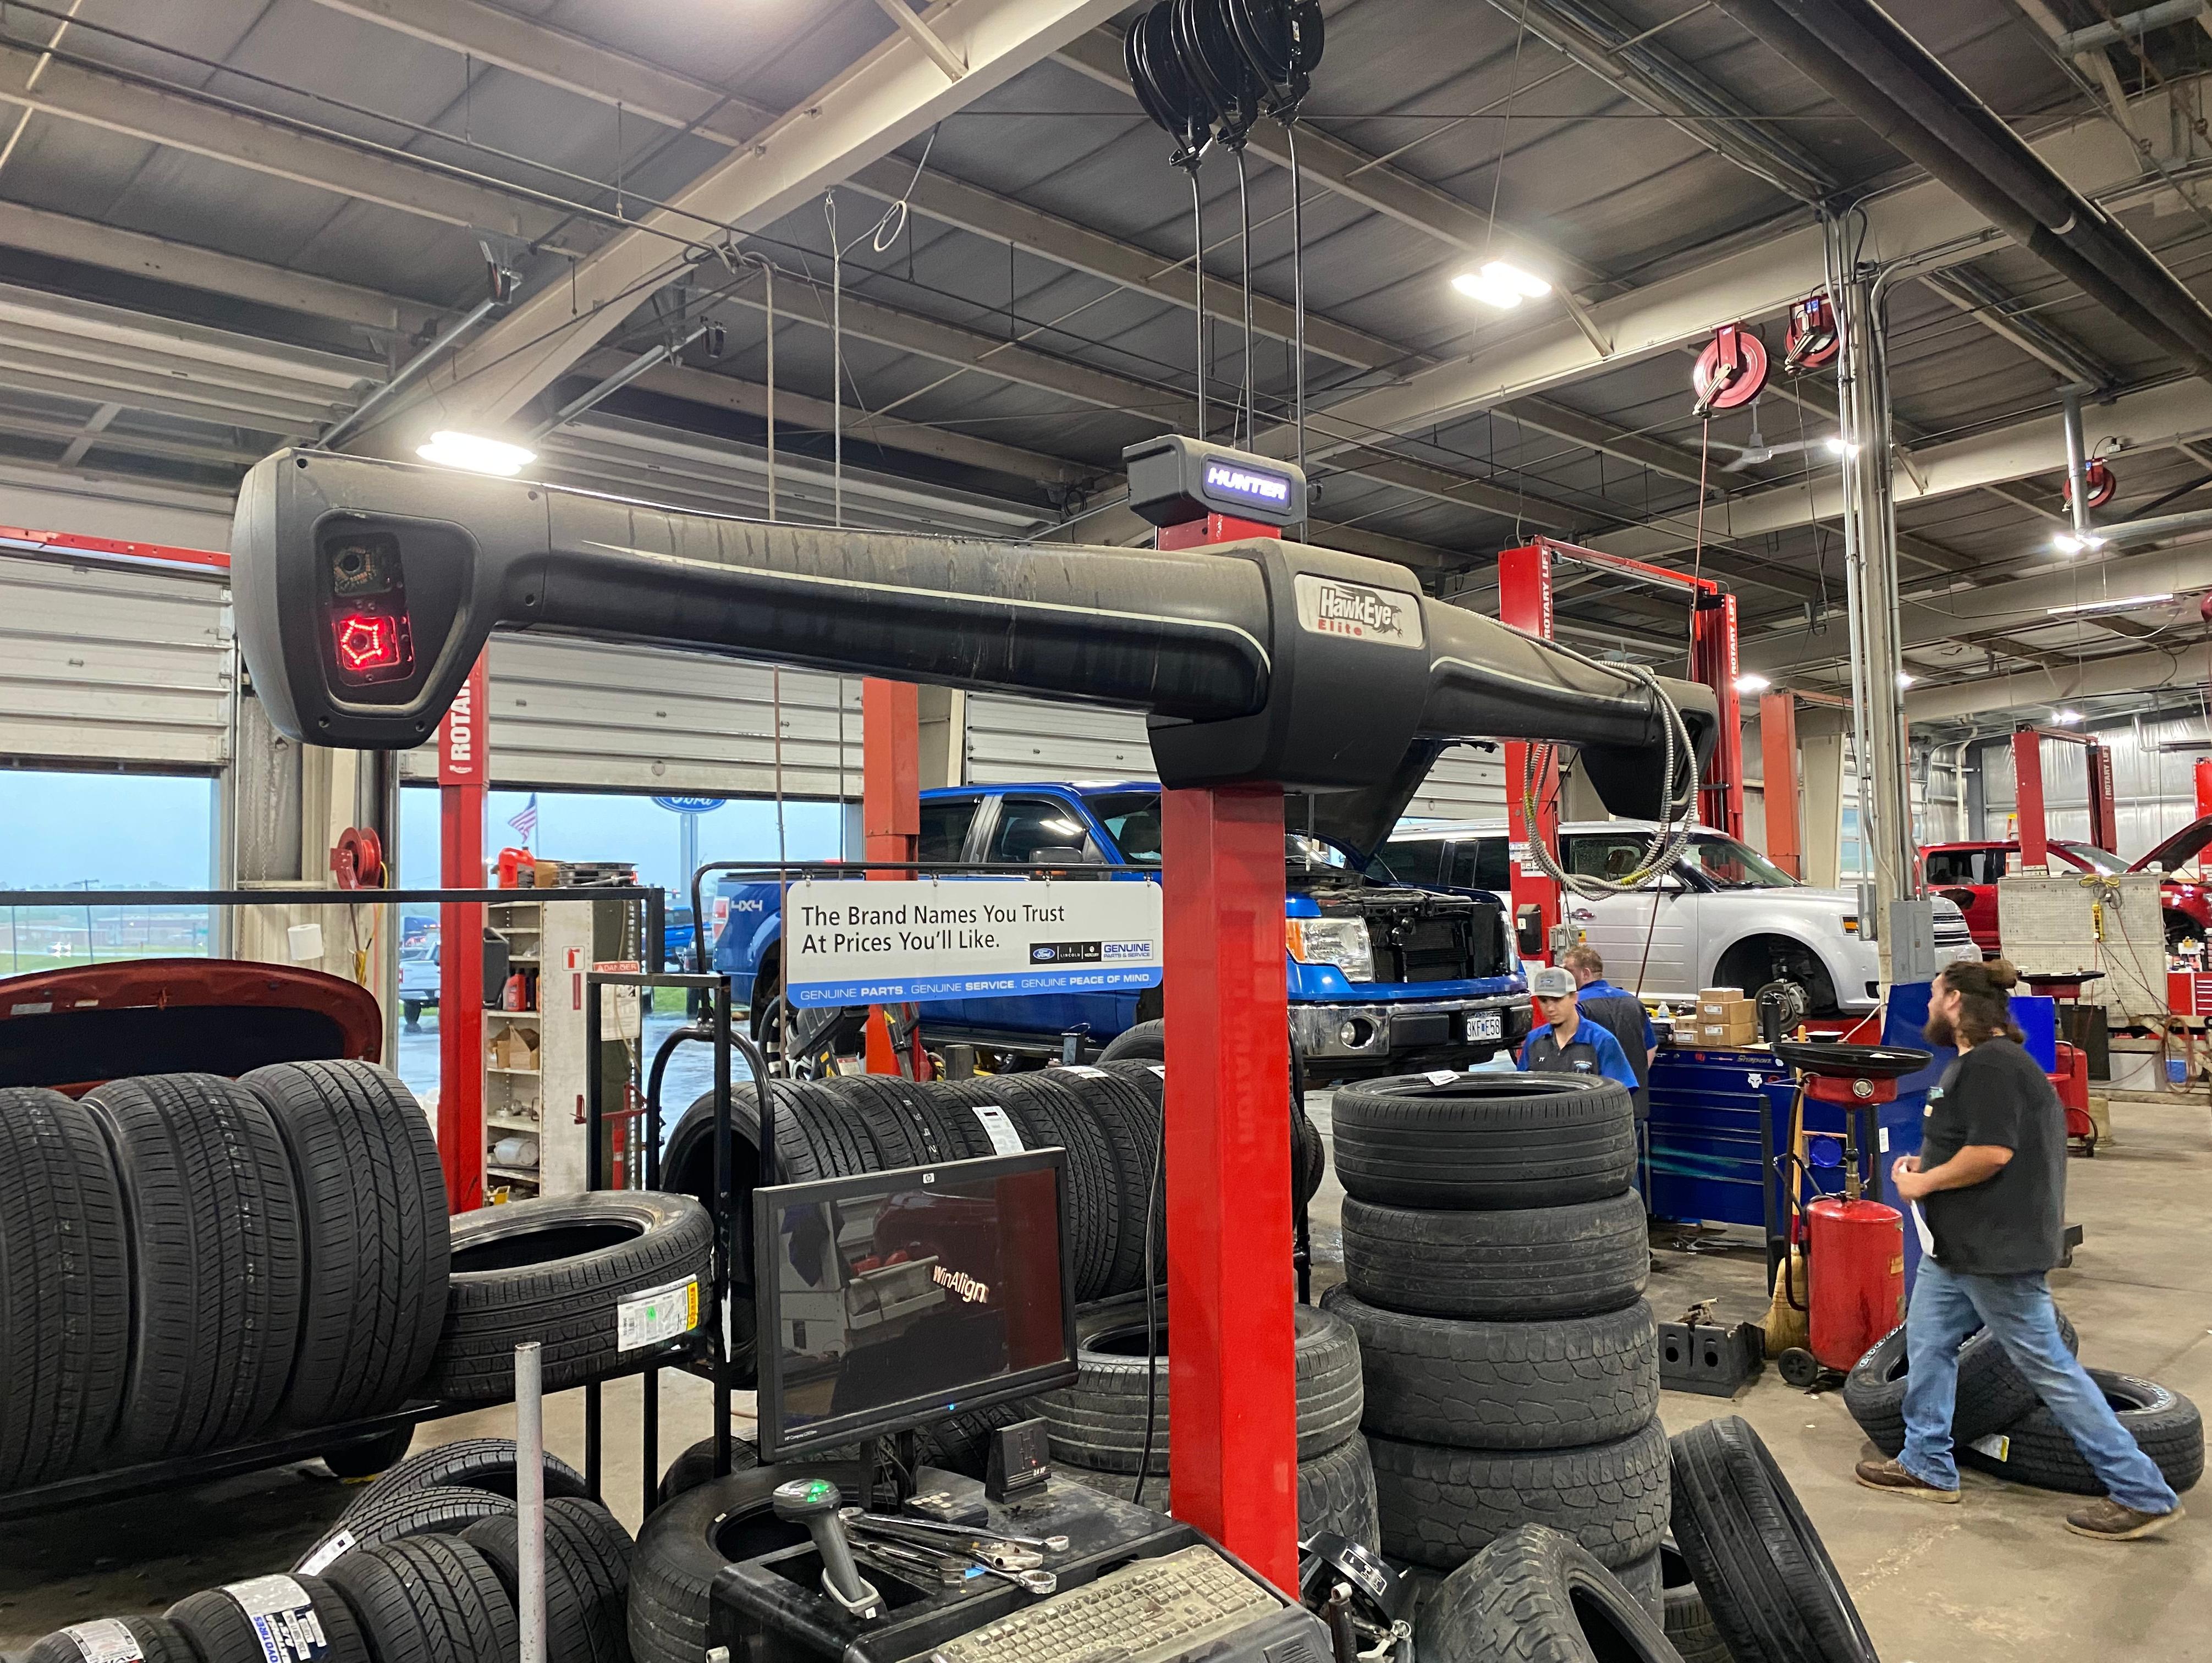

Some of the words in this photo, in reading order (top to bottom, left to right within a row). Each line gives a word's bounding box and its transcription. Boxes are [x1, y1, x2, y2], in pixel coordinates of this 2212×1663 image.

[1208, 467, 1286, 500] HUNTER
[1320, 588, 1392, 627] HawkEye
[1318, 619, 1363, 636] Elite
[801, 905, 840, 926] The
[848, 905, 906, 925] Brand
[914, 905, 976, 924] Names
[983, 905, 1016, 923] You
[1022, 905, 1064, 922] Trust
[801, 934, 827, 954] At
[834, 932, 891, 952] Prices
[899, 929, 951, 950] You'll
[959, 929, 999, 948] Like.
[1104, 944, 1150, 952] GENUINE
[604, 963, 637, 972] DANGER
[801, 989, 857, 1000] GENUINE
[861, 986, 906, 996] PARTS.
[911, 983, 962, 994] GENUINE
[965, 980, 1017, 990] SERVICE.
[1021, 978, 1067, 988] GENUINE
[1070, 976, 1104, 985] PEACE
[1107, 975, 1120, 983] OF
[1123, 973, 1152, 982] MIND.
[933, 1265, 987, 1303] WinAlign
